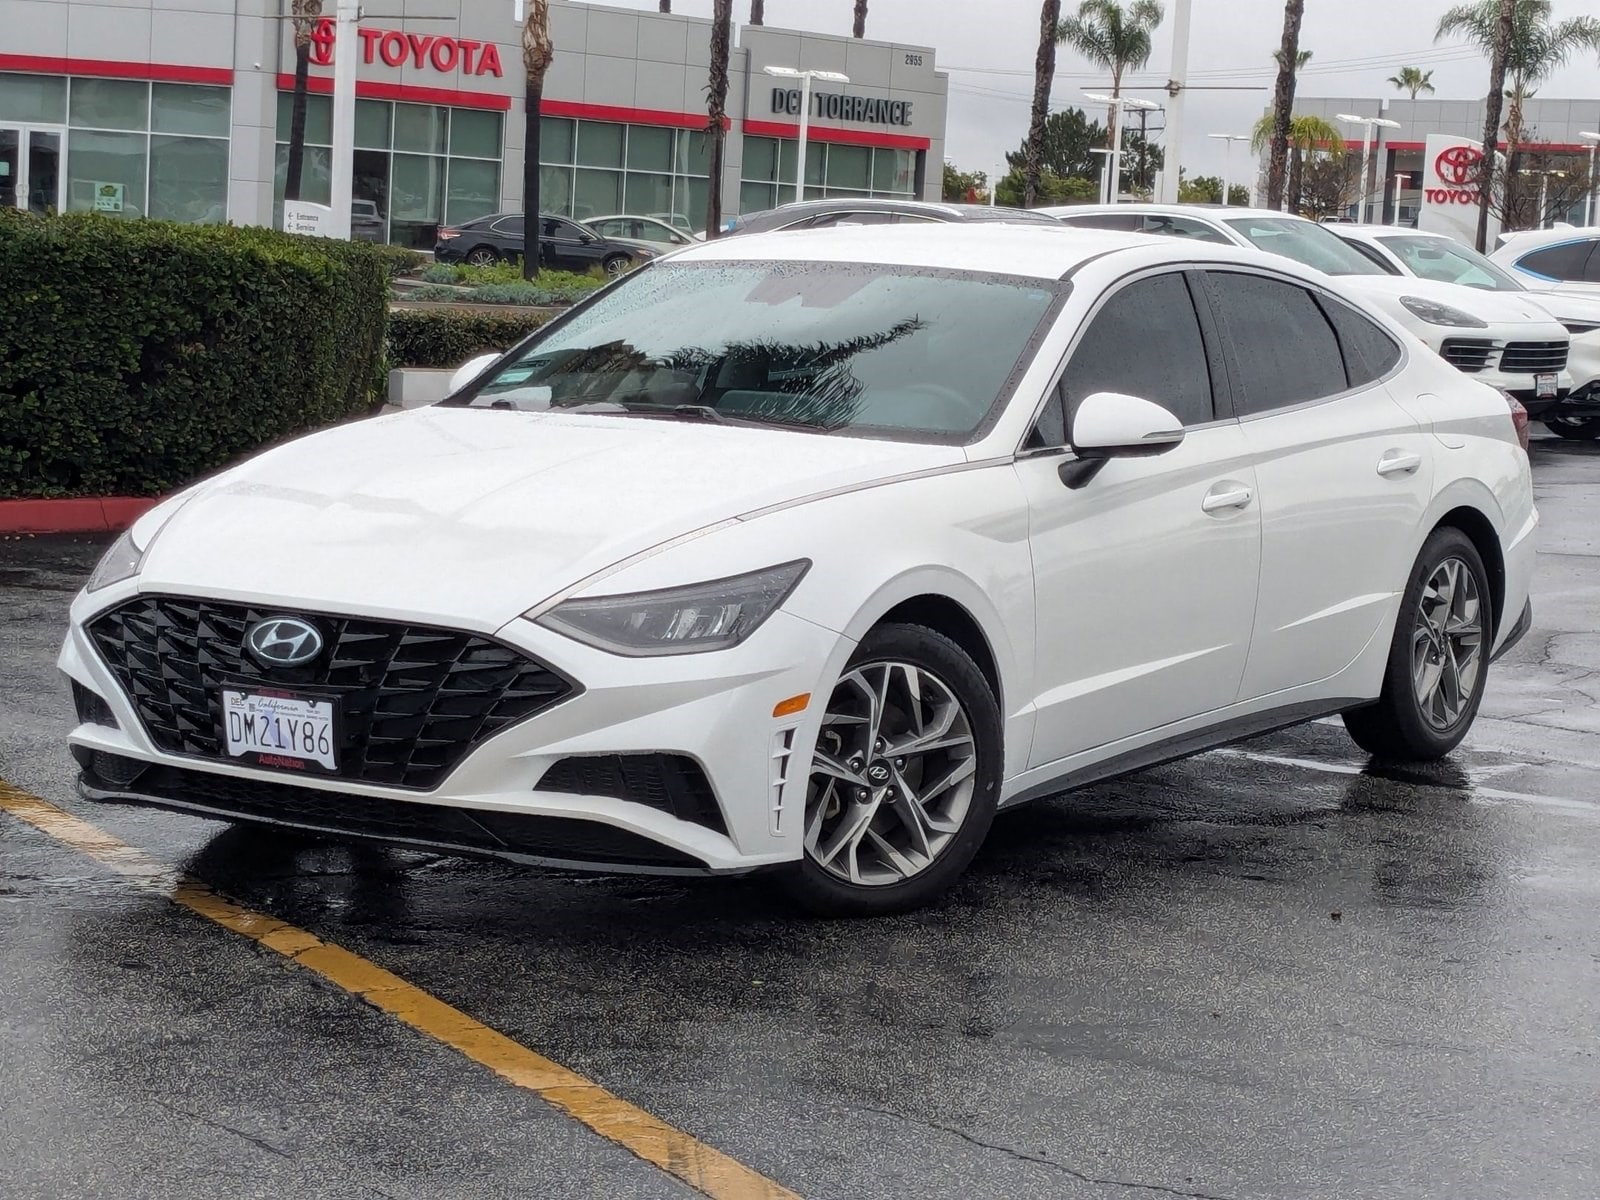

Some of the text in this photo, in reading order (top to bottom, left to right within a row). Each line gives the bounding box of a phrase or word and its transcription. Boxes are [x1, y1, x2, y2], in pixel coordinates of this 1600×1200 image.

[358, 28, 504, 77] TOYOTA
[816, 92, 913, 126] TORRANCE
[258, 697, 299, 713] California
[229, 711, 329, 755] DM21Y86
